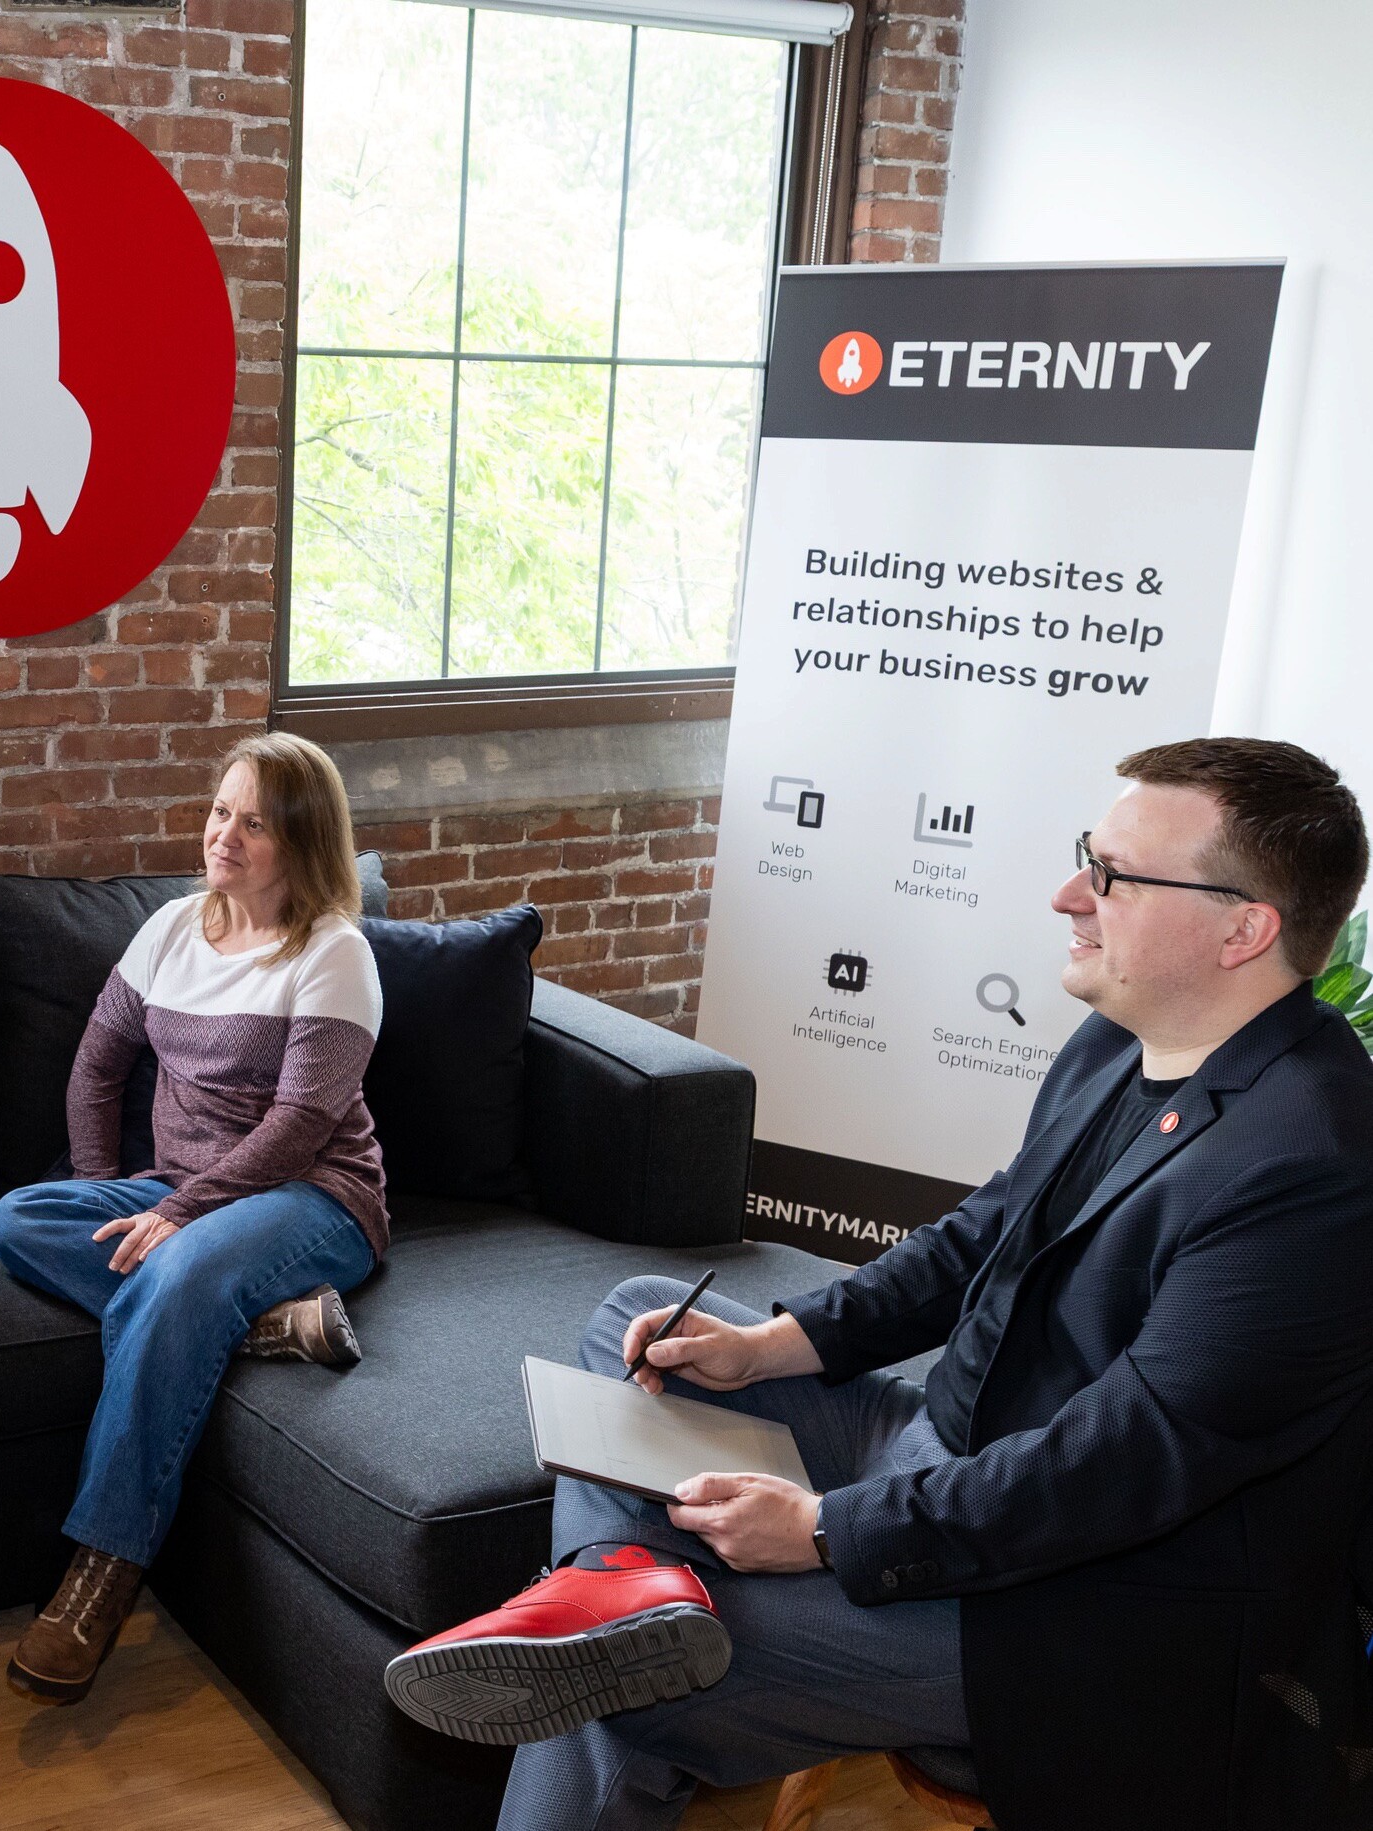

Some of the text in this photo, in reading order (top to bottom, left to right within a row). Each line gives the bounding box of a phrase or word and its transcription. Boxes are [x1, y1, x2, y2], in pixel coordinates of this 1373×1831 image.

[888, 341, 1212, 391] ETERNITY
[805, 548, 1163, 596] Building websites &
[792, 597, 1164, 653] relationships to help
[794, 648, 1149, 698] your business grow
[771, 841, 804, 858] Web
[758, 860, 813, 883] Design
[912, 859, 967, 881] Digital
[894, 879, 979, 908] Marketing
[834, 964, 859, 982] AI
[809, 1005, 875, 1030] Artificial
[792, 1023, 887, 1053] Intelligence
[932, 1027, 1058, 1062] Search Engine
[938, 1049, 1047, 1081] Optimization
[745, 1192, 909, 1246] ERNITYMAR
